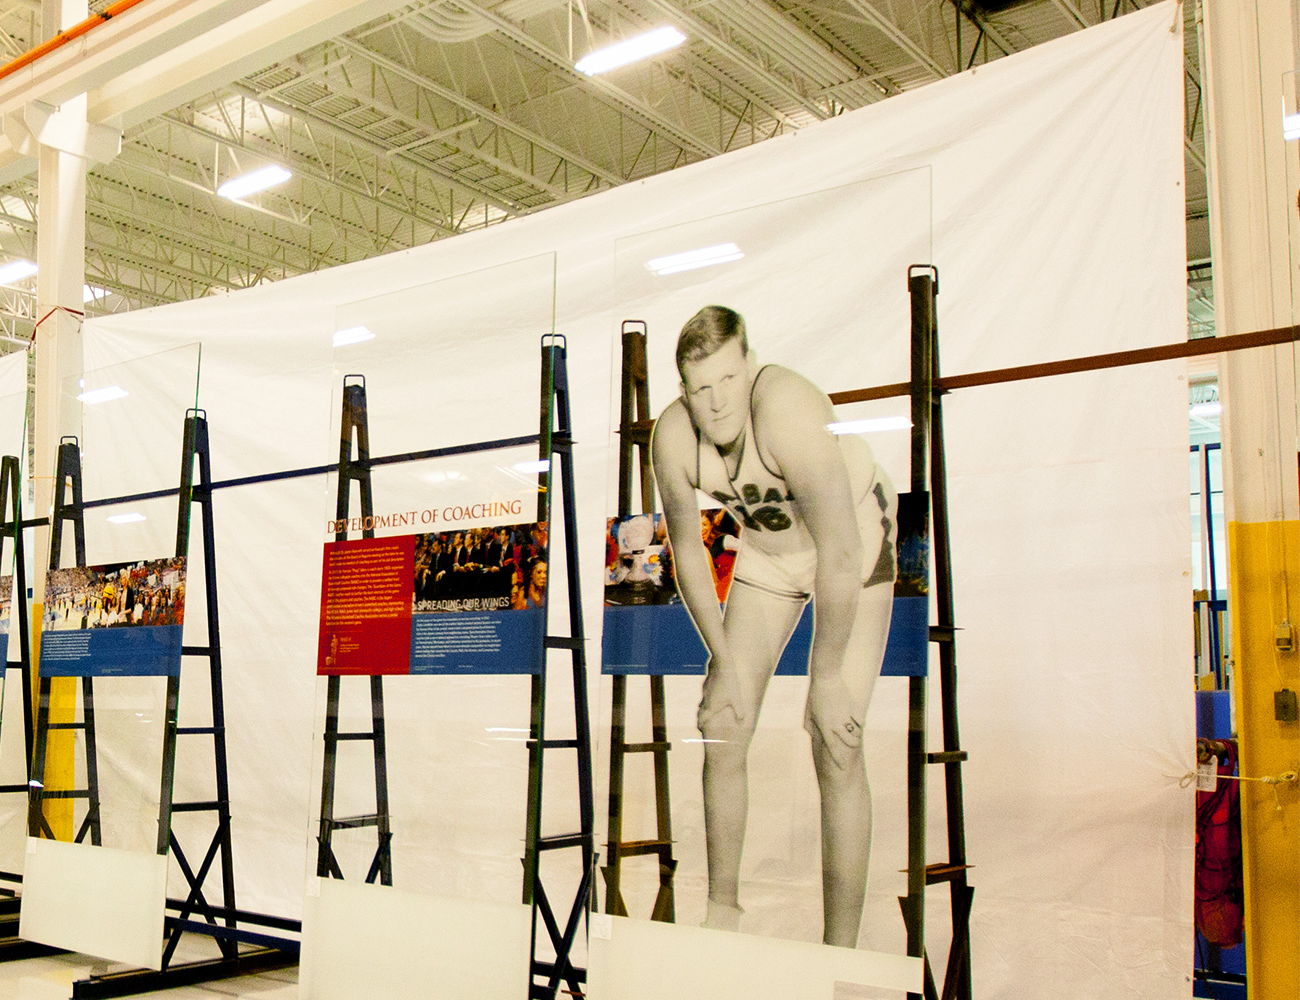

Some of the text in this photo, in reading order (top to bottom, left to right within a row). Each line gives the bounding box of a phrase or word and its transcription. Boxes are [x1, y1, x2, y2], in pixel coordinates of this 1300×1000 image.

[326, 500, 522, 534] DEVELOPMENT OF COACHING
[417, 599, 460, 611] SPREADING
[481, 597, 510, 609] WINGS
